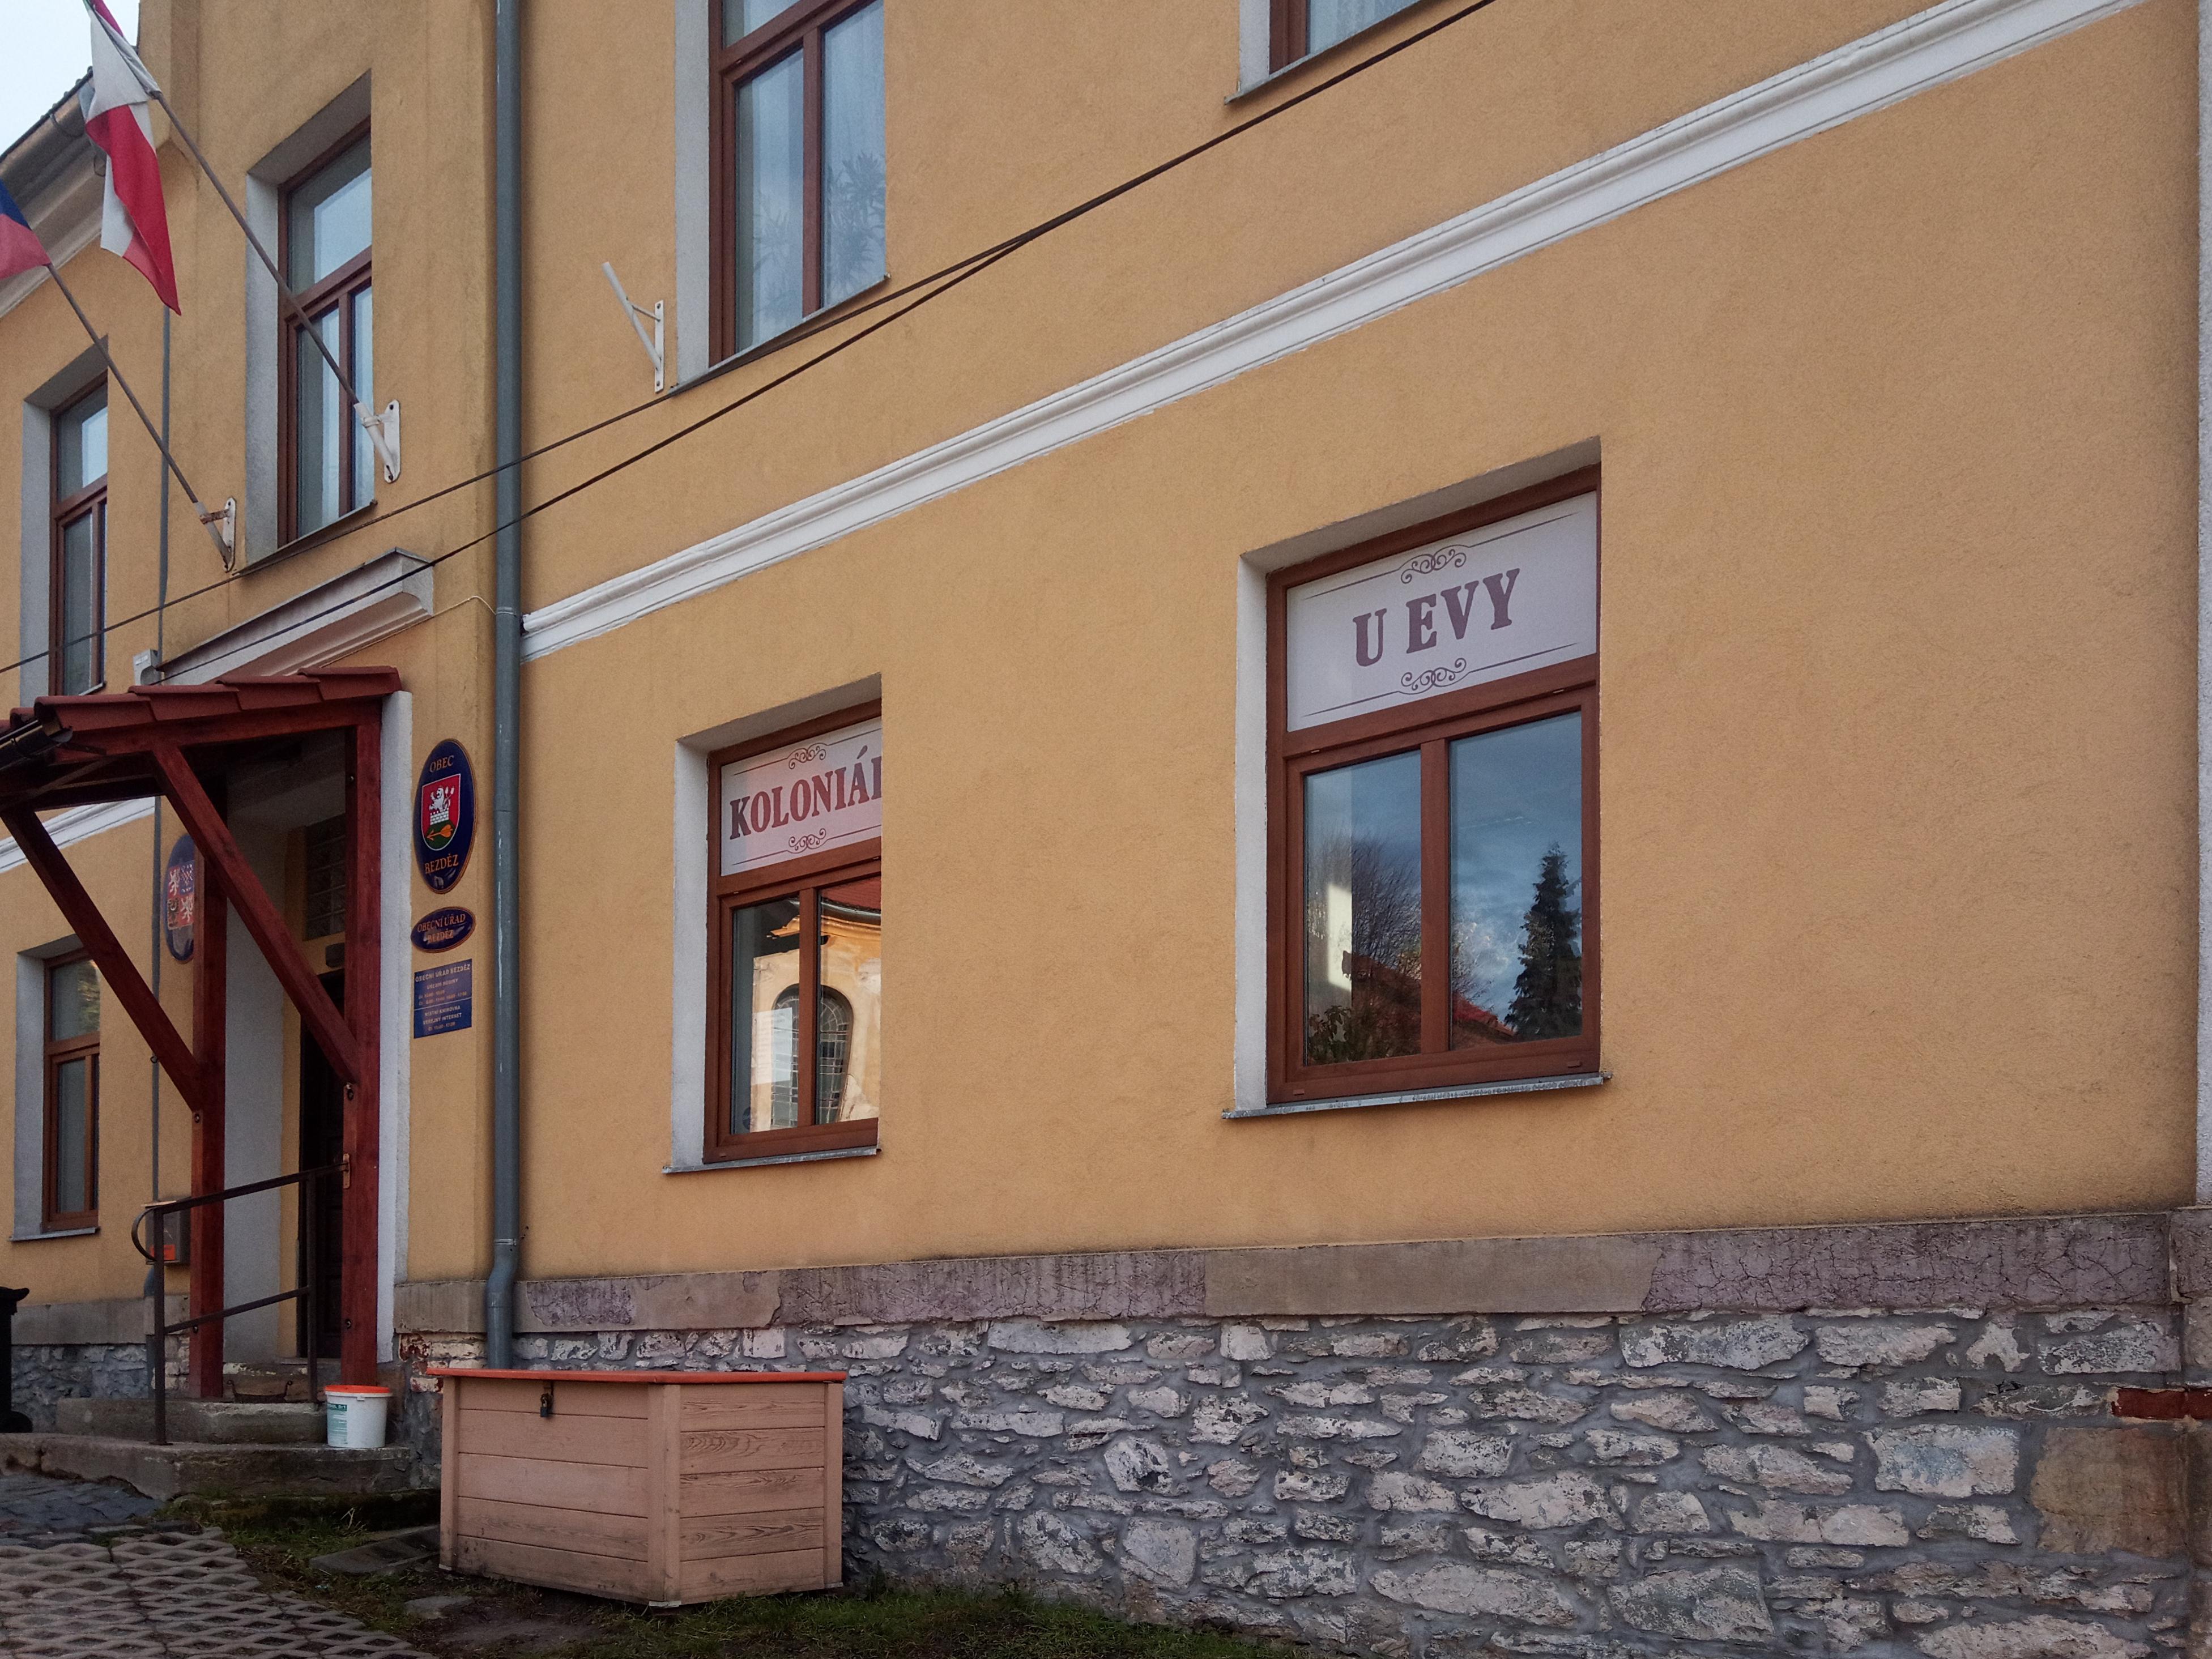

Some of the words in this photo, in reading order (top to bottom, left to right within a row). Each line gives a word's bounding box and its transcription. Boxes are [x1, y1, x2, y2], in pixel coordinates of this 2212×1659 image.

[1352, 608, 1387, 667] U
[1405, 568, 1520, 654] EVY
[429, 755, 454, 773] OBEC
[425, 853, 459, 874] BEZDĚZ
[417, 916, 443, 932] OBECNÍ
